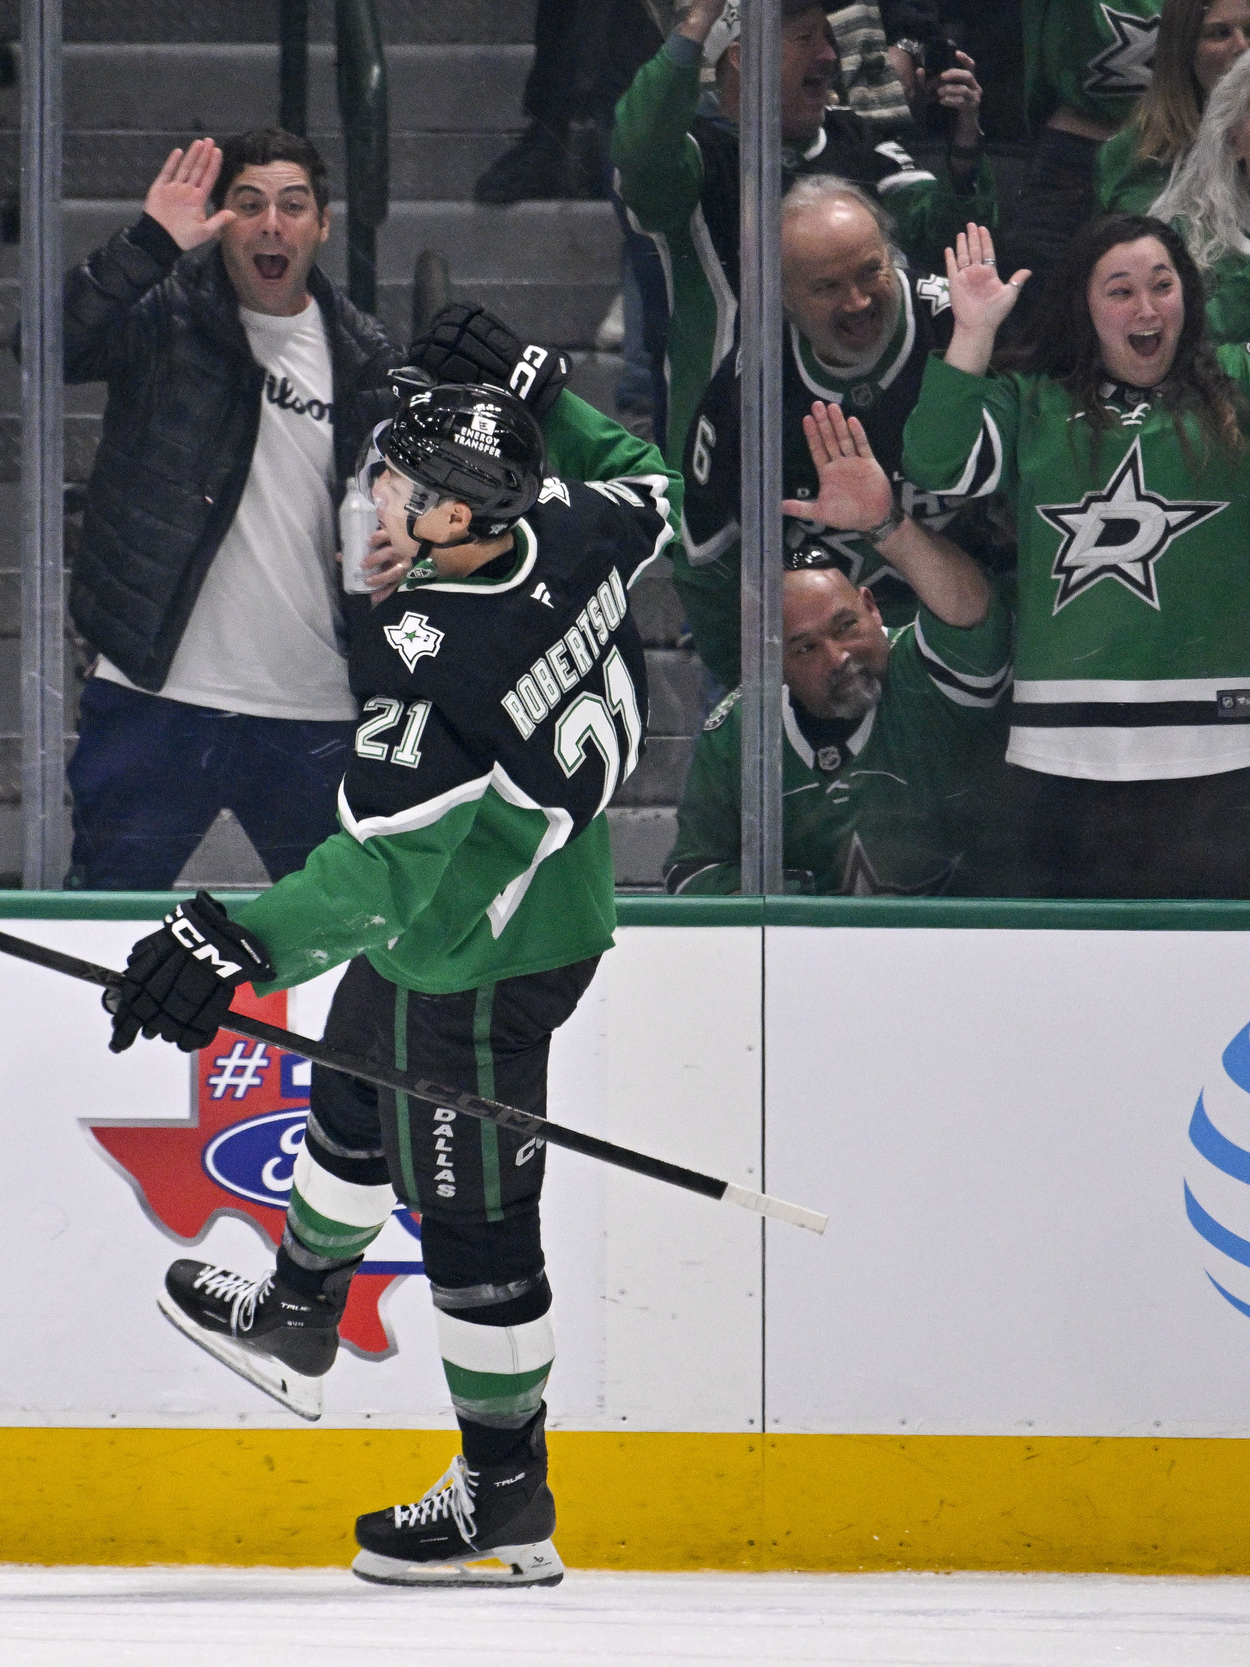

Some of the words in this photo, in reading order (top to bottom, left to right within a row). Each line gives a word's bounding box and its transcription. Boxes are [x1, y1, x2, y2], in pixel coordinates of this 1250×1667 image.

[266, 375, 333, 424] ilso
[510, 345, 548, 400] CC
[454, 433, 502, 458] TRANSFER
[460, 426, 500, 447] ENERGY
[501, 566, 628, 741] ROBERTSON
[355, 697, 434, 769] 21
[554, 645, 643, 819] 21
[432, 1107, 457, 1198] DALLAS
[494, 1472, 526, 1488] TRUE
